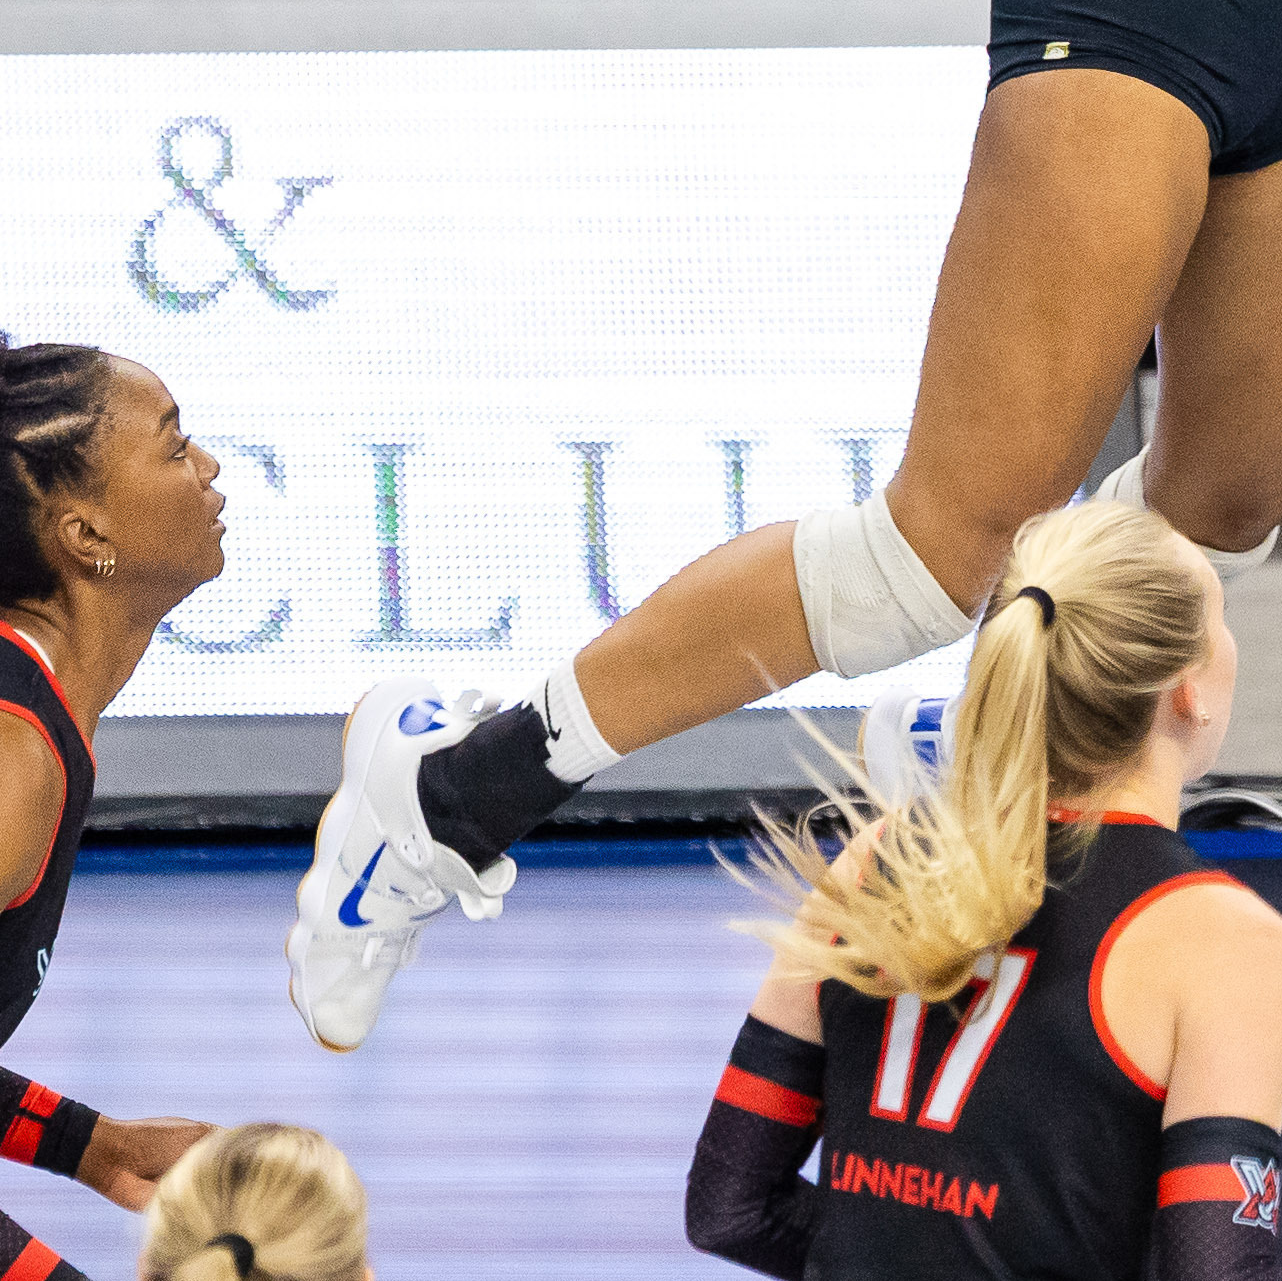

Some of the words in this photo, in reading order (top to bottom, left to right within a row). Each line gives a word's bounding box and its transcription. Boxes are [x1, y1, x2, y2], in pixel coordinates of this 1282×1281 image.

[126, 114, 338, 314] &
[869, 946, 1039, 1134] 17
[830, 1150, 999, 1221] LINNEHAN
